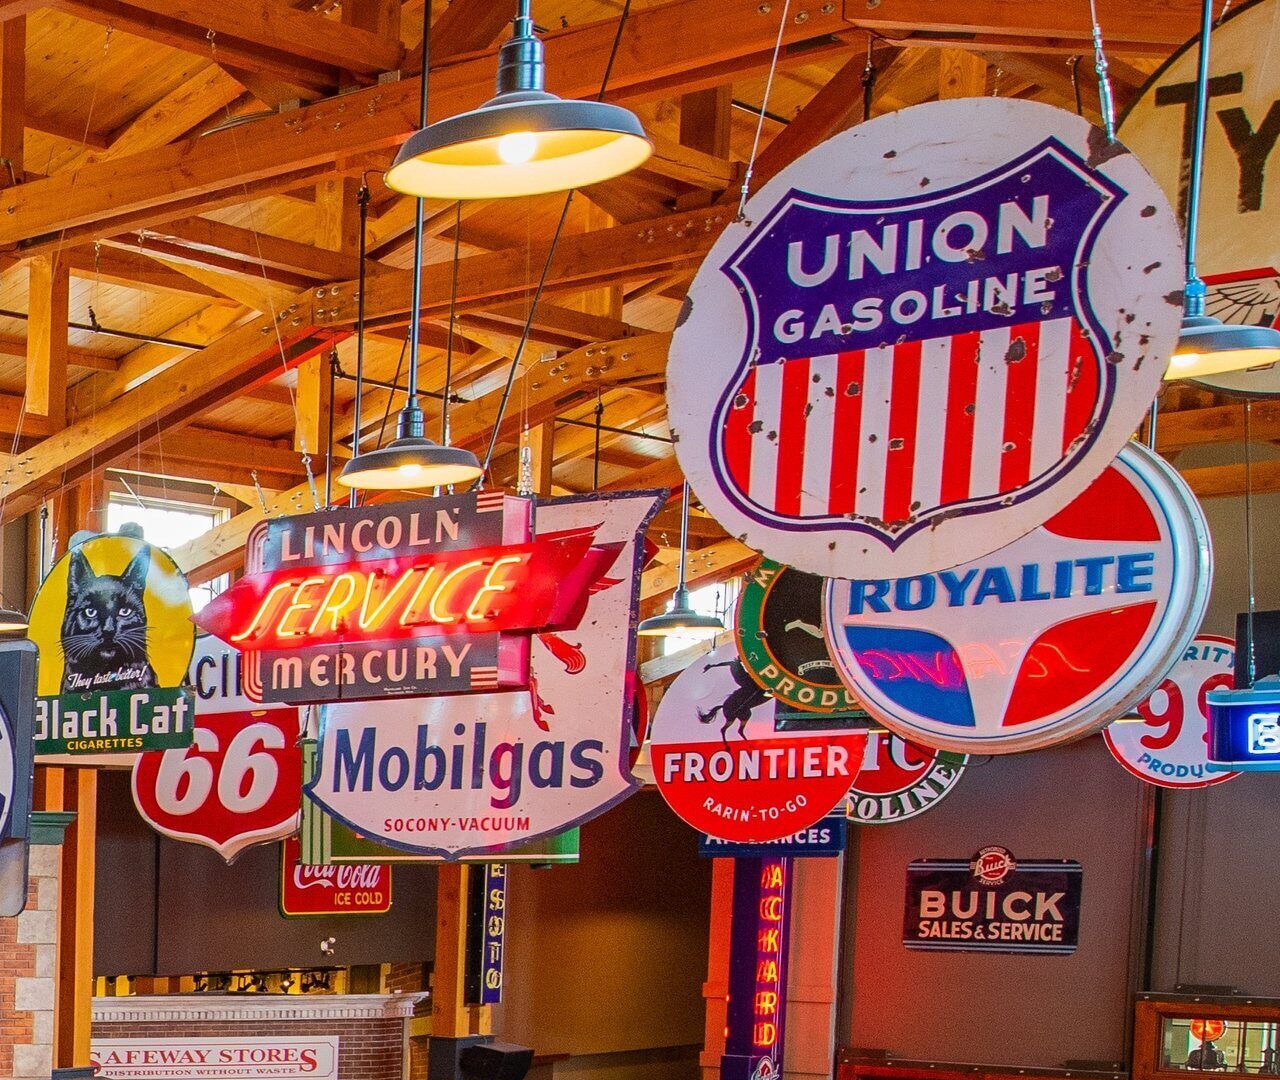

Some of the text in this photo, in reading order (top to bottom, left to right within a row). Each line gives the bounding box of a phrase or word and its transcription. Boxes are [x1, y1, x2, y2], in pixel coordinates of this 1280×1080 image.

[787, 194, 1050, 288] UNION
[774, 265, 1057, 344] GASOLINE
[281, 508, 460, 562] LINCOLN
[231, 553, 527, 641] SERVICE
[848, 552, 1155, 616] ROYALITE
[67, 671, 92, 689] They
[272, 643, 471, 690] MERCURY
[759, 664, 860, 706] PRODU
[34, 693, 188, 740] Black Cat
[67, 737, 143, 751] CIGARETTES
[663, 745, 850, 783] FRONTIER
[155, 722, 285, 816] 66
[332, 722, 605, 810] Mobilgas
[384, 816, 530, 833] SOCONY-VACUUM
[974, 854, 1013, 877] Buick
[334, 892, 383, 905] ICE COLD
[920, 890, 1066, 921] BUICK
[918, 920, 1064, 942] SALES & SERVICE
[753, 864, 783, 1047] ACKARD
[90, 1048, 318, 1075] SAFEWAY STORES
[105, 1067, 297, 1077] DISTRIBUTION WITHOUT WASTE
